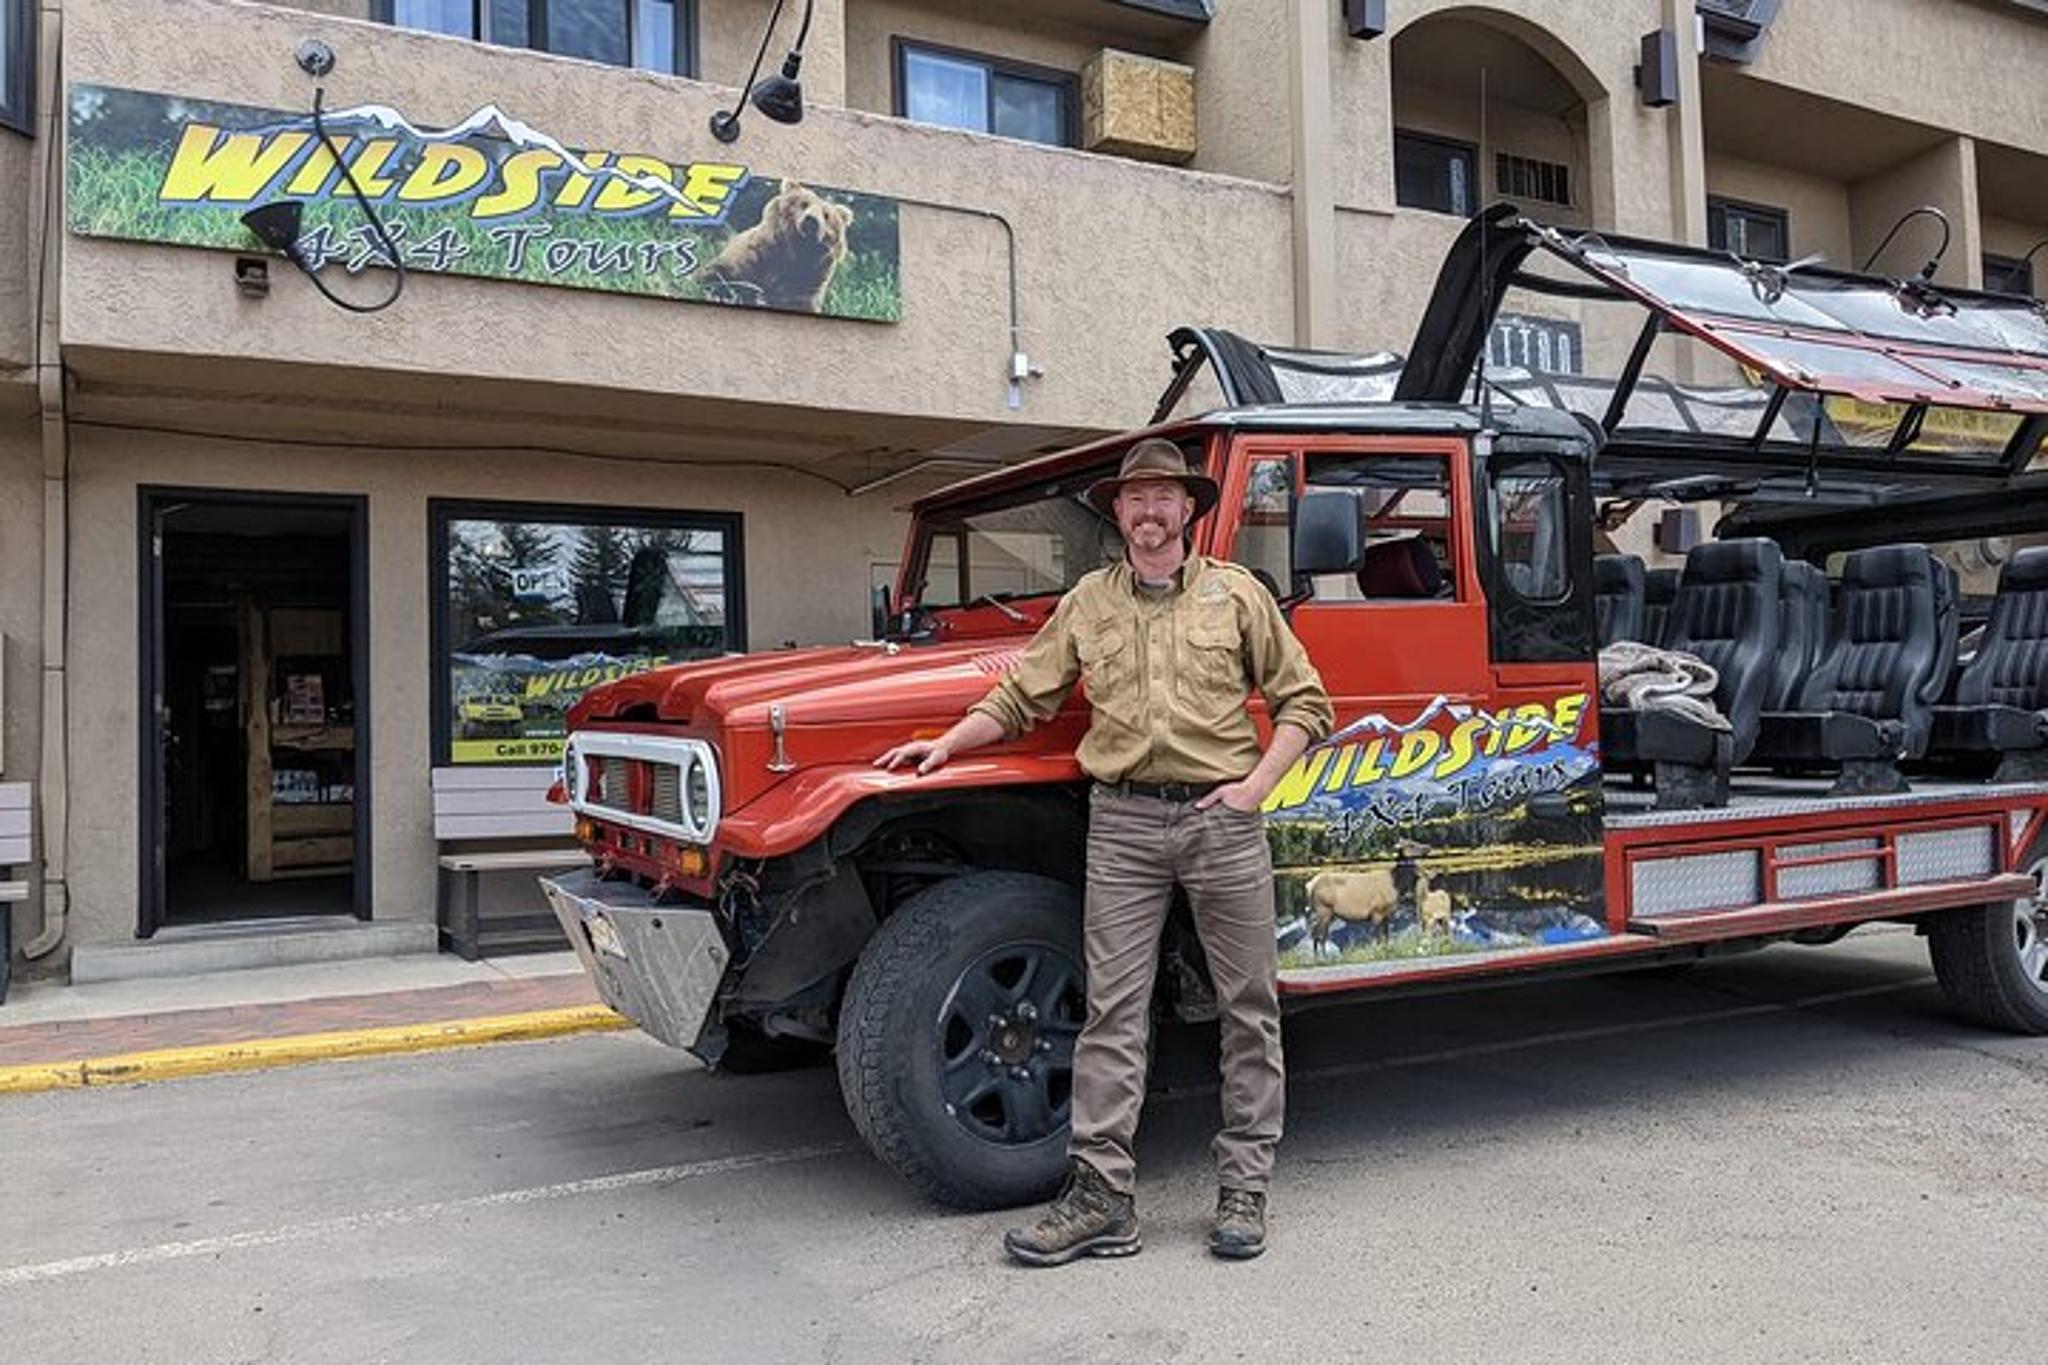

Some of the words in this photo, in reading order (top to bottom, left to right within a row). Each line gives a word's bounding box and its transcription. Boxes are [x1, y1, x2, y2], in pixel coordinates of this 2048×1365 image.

[158, 122, 750, 218] WILDSIDE
[490, 223, 699, 275] Tours
[496, 744, 527, 757] Call
[1447, 761, 1569, 812] Tours
